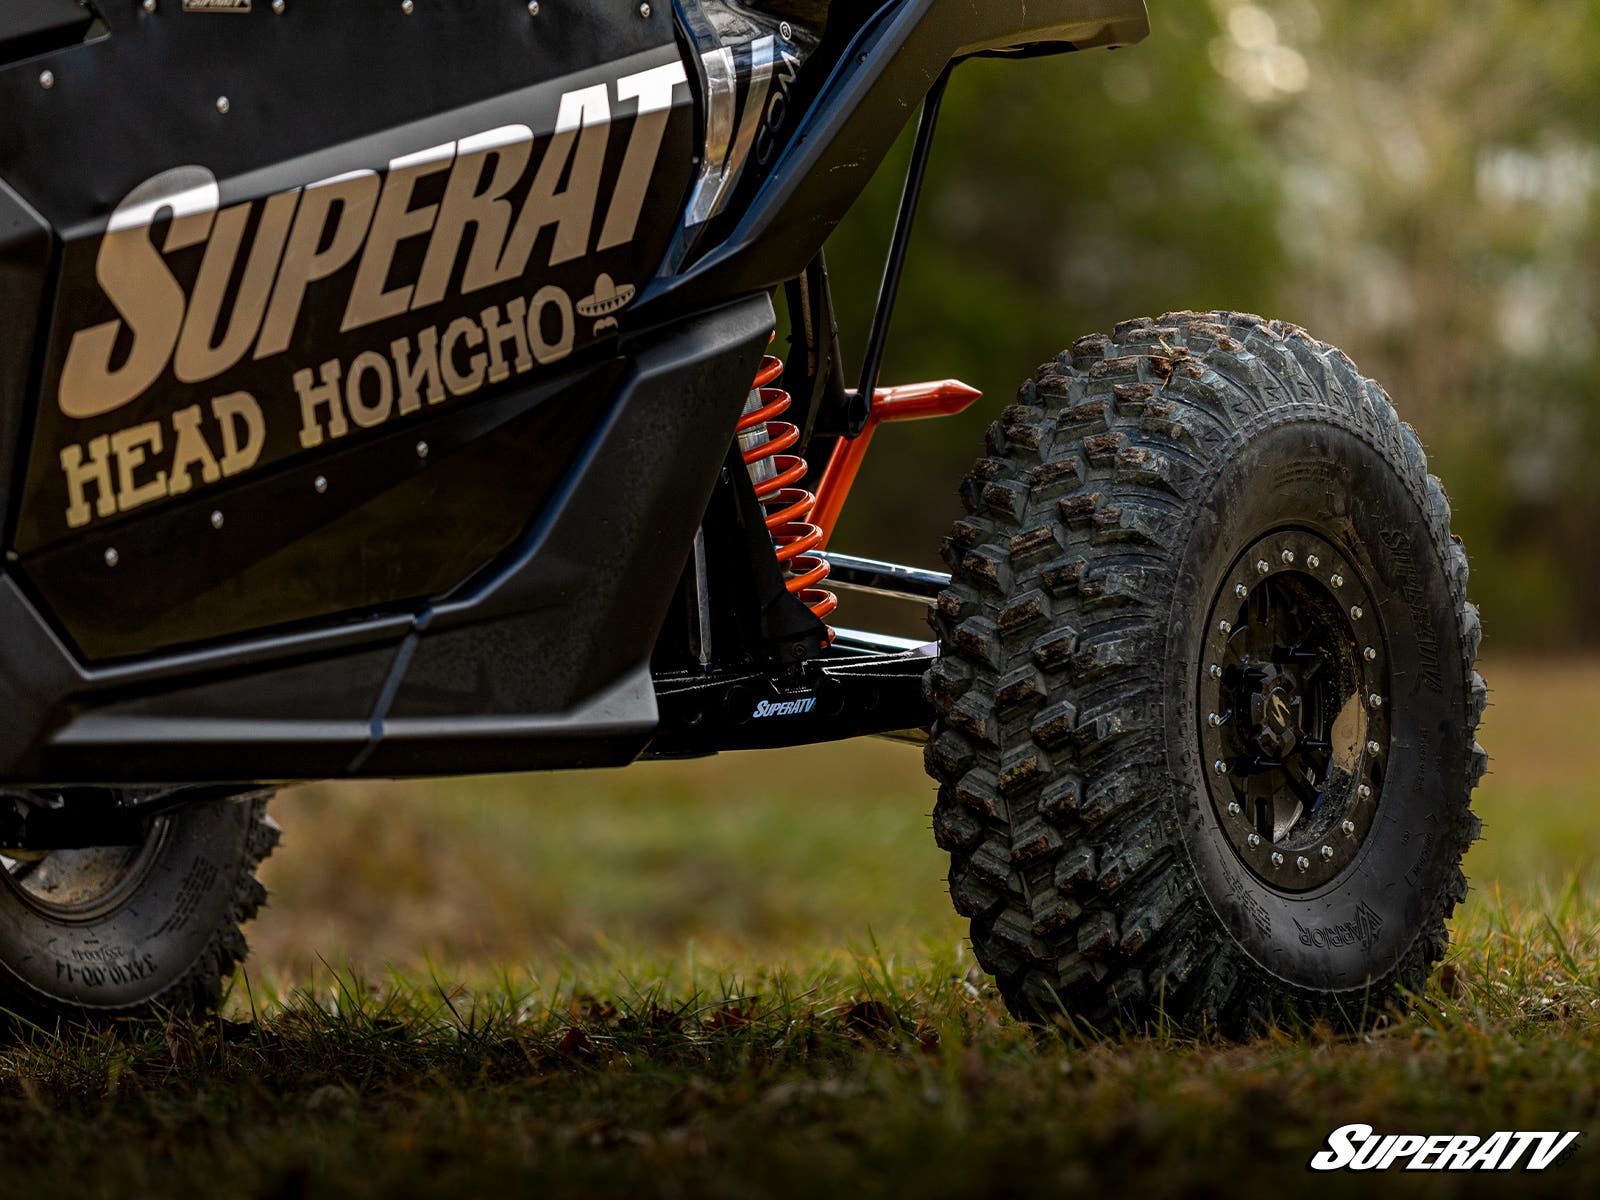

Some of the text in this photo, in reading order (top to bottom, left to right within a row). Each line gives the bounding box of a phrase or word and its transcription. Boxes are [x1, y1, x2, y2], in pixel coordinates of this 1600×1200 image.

[60, 390, 266, 529] HEAD
[753, 697, 817, 719] SUPERATV
[1292, 900, 1385, 950] WARRIOR
